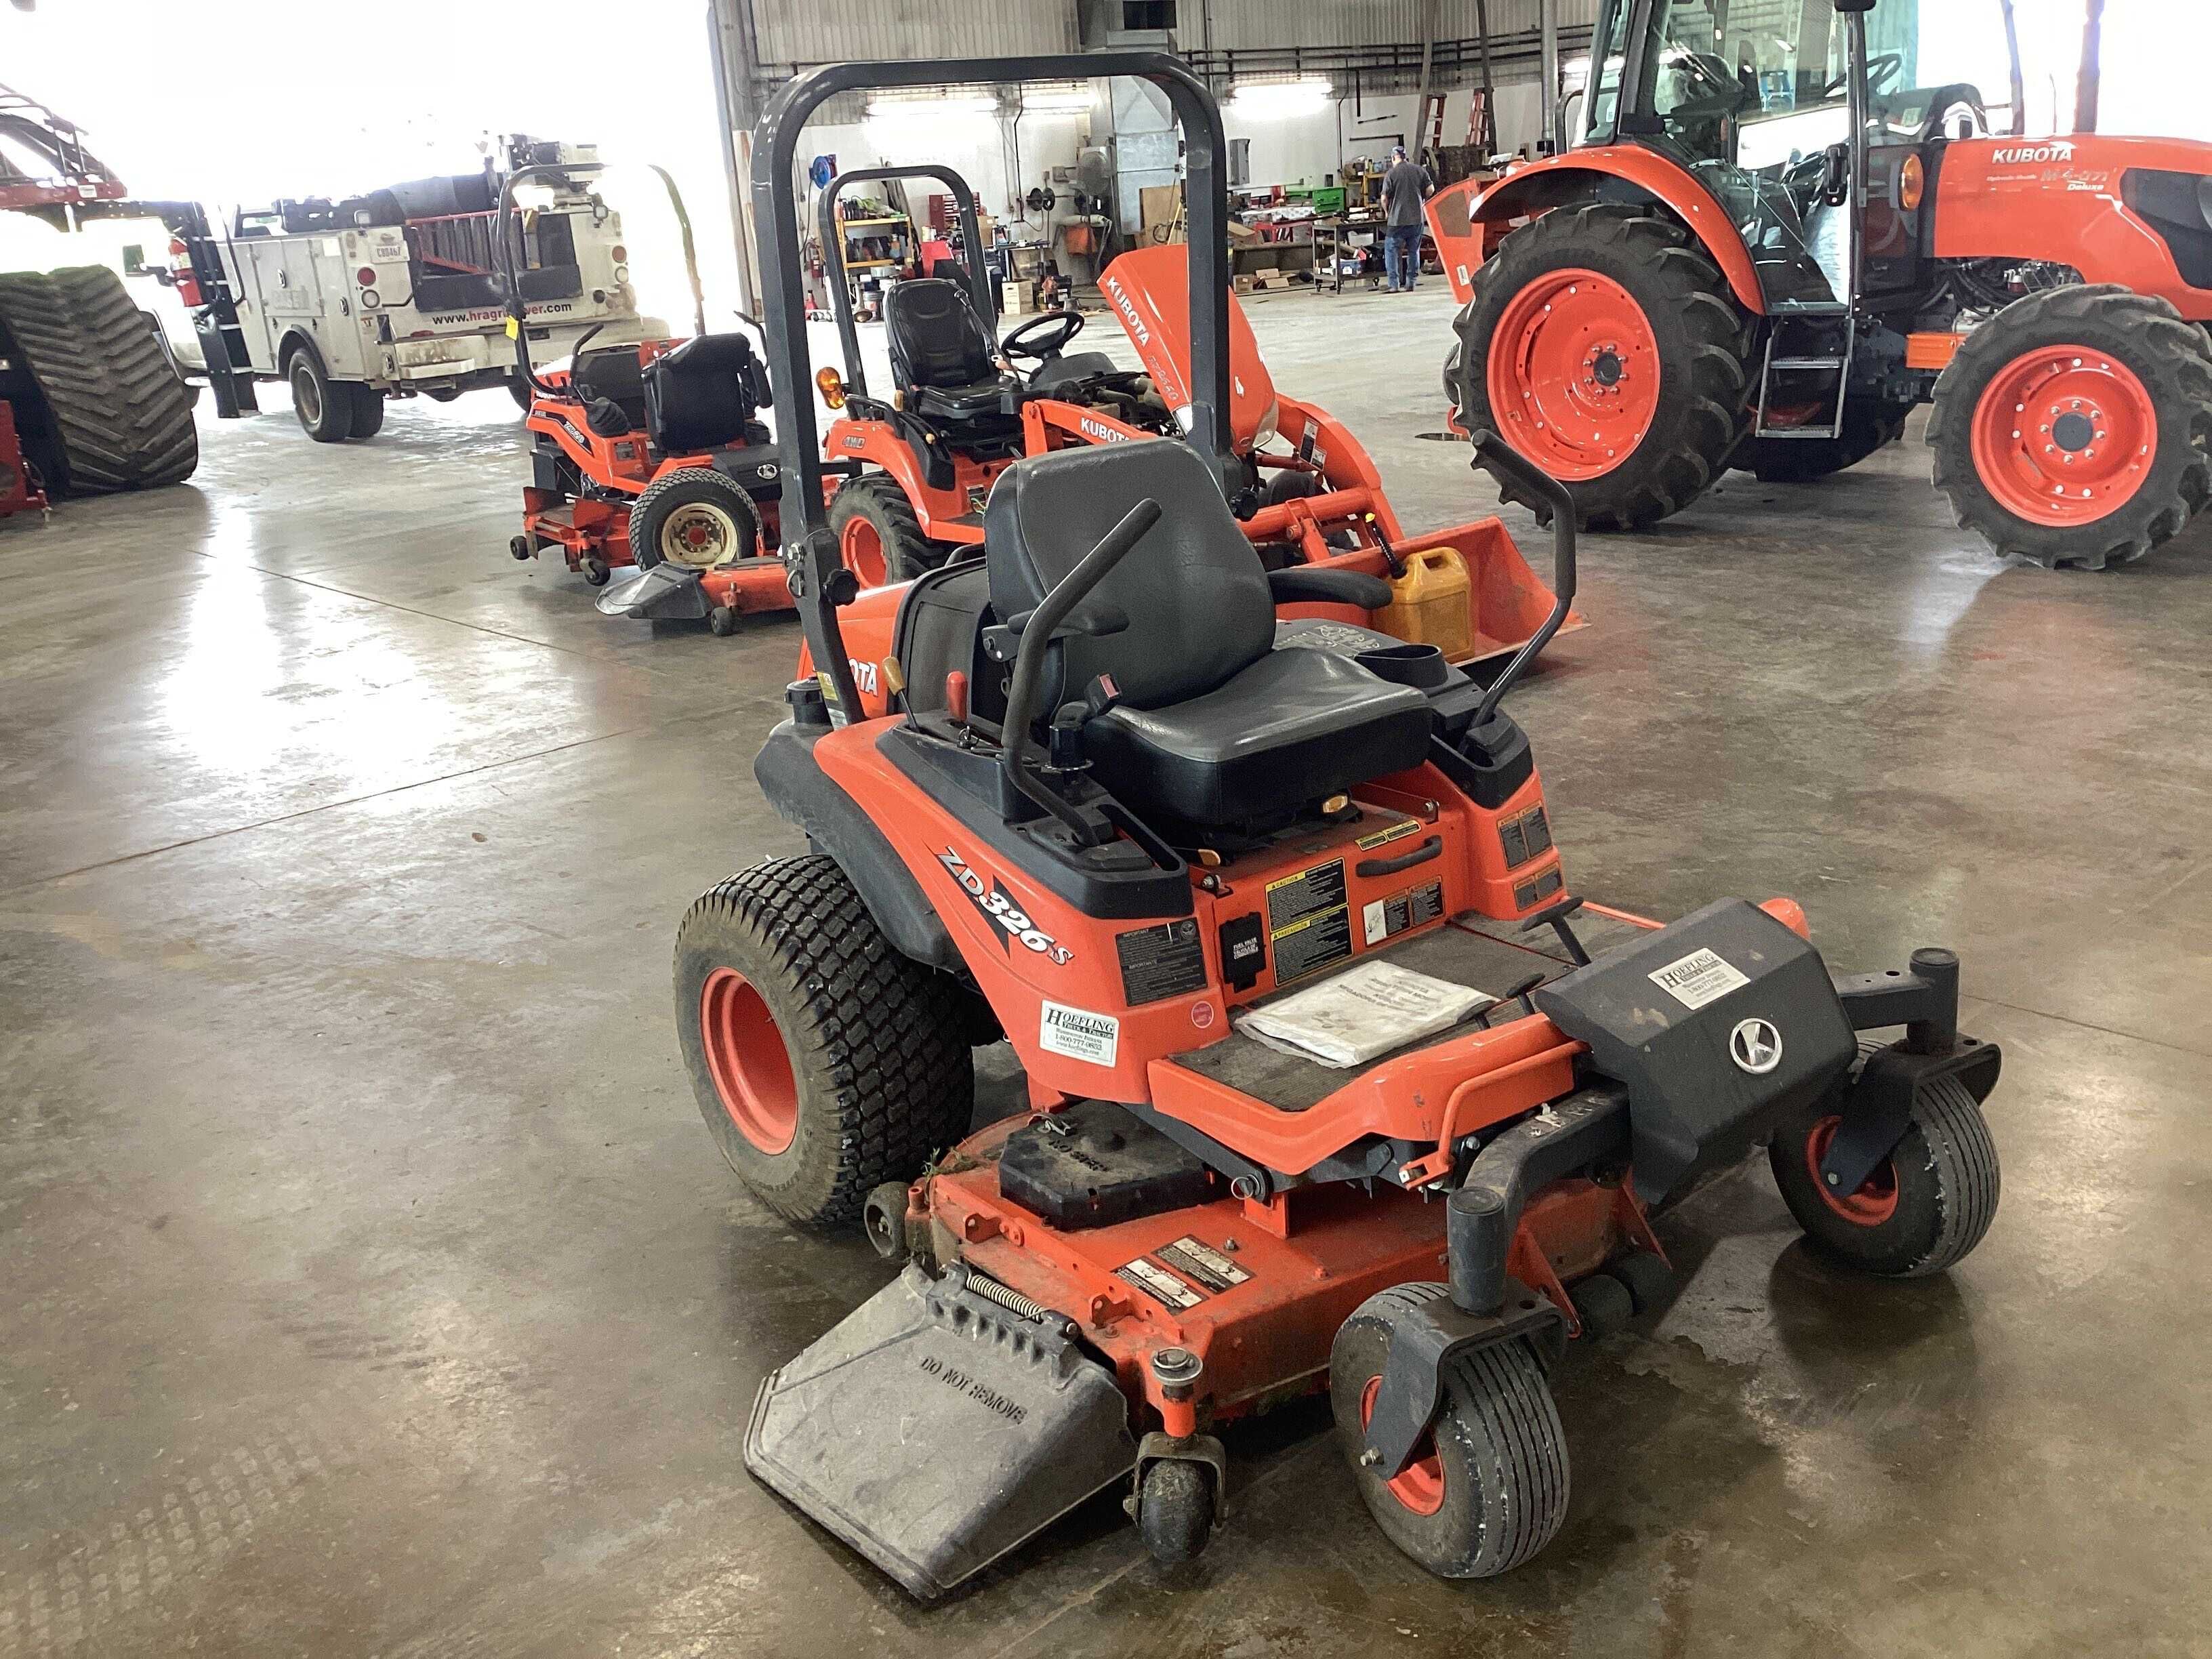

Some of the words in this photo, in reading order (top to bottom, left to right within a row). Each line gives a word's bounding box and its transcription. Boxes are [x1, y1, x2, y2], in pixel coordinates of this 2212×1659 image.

[1992, 147, 2072, 164] KUBOTA
[1106, 276, 1151, 348] KUBOTA
[842, 435, 865, 449] 4WD
[848, 658, 879, 697] OTA
[1276, 876, 1298, 887] CAUTION
[1123, 928, 1149, 937] IMPORTANT
[1660, 954, 1715, 989] HOEFLING
[1046, 1008, 1115, 1032] HOEFLING
[920, 1356, 943, 1375] DO
[942, 1368, 974, 1391] NOT
[968, 1382, 1029, 1425] REMOVE
